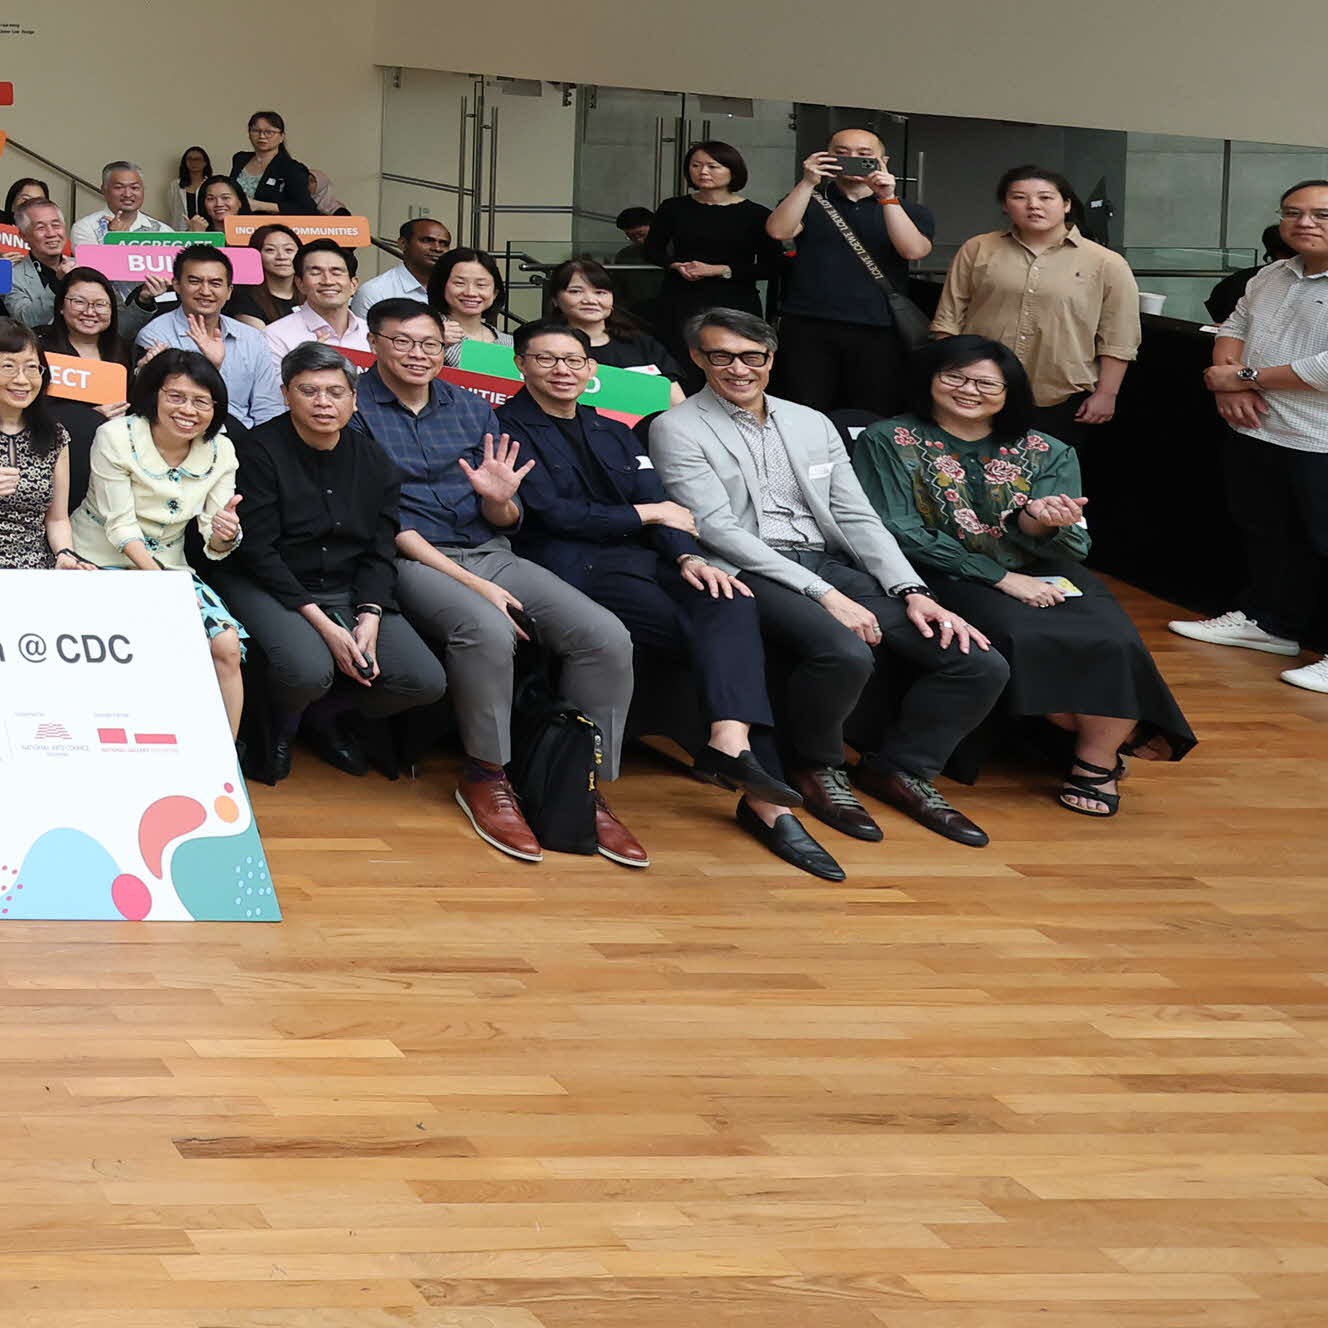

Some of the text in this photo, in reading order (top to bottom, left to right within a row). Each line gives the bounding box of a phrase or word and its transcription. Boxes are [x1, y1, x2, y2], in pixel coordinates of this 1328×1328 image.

[295, 227, 359, 236] OMMUNITIES
[826, 208, 848, 231] LOEWE
[843, 231, 866, 255] LOEWE
[860, 255, 884, 280] LOEWE
[18, 635, 48, 663] @
[55, 634, 134, 664] CDC
